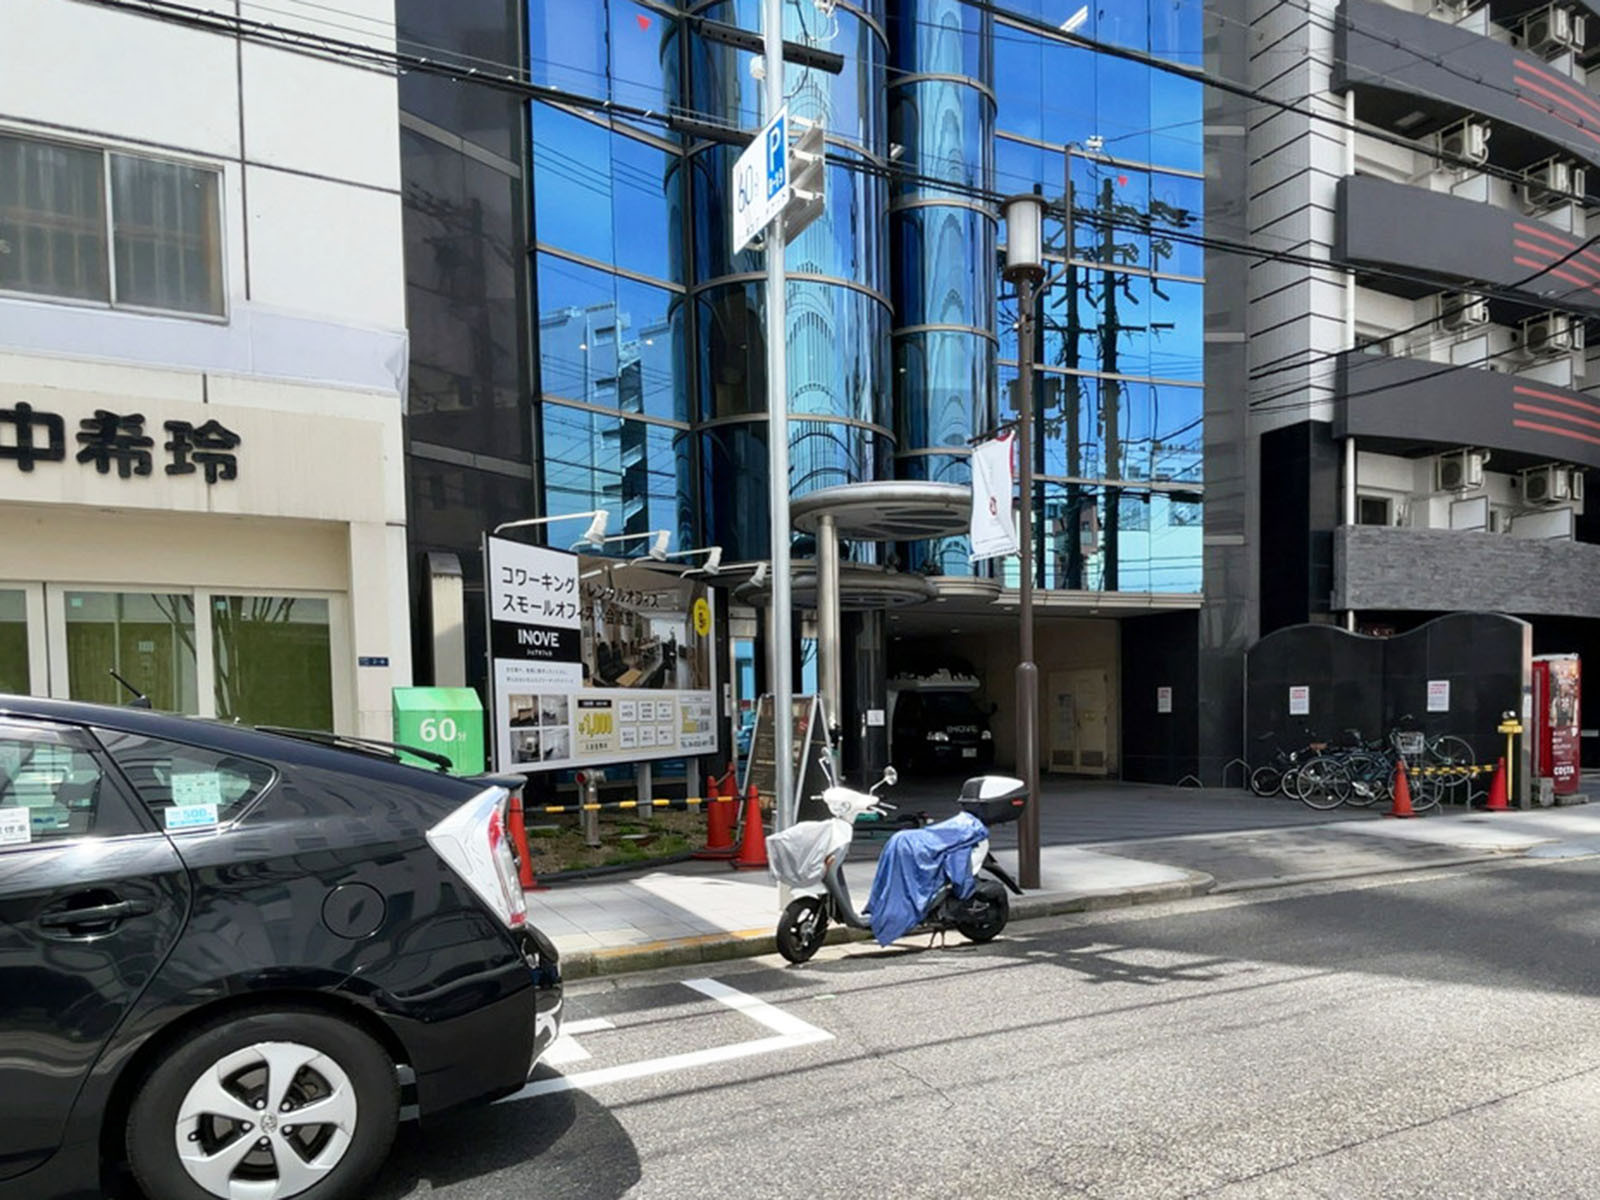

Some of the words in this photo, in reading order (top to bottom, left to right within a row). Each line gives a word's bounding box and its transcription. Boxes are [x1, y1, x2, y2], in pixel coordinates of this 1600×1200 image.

[770, 127, 780, 172] P
[0, 401, 242, 485] 中希玲
[517, 628, 560, 648] INOVE
[1553, 764, 1575, 777] COSTA
